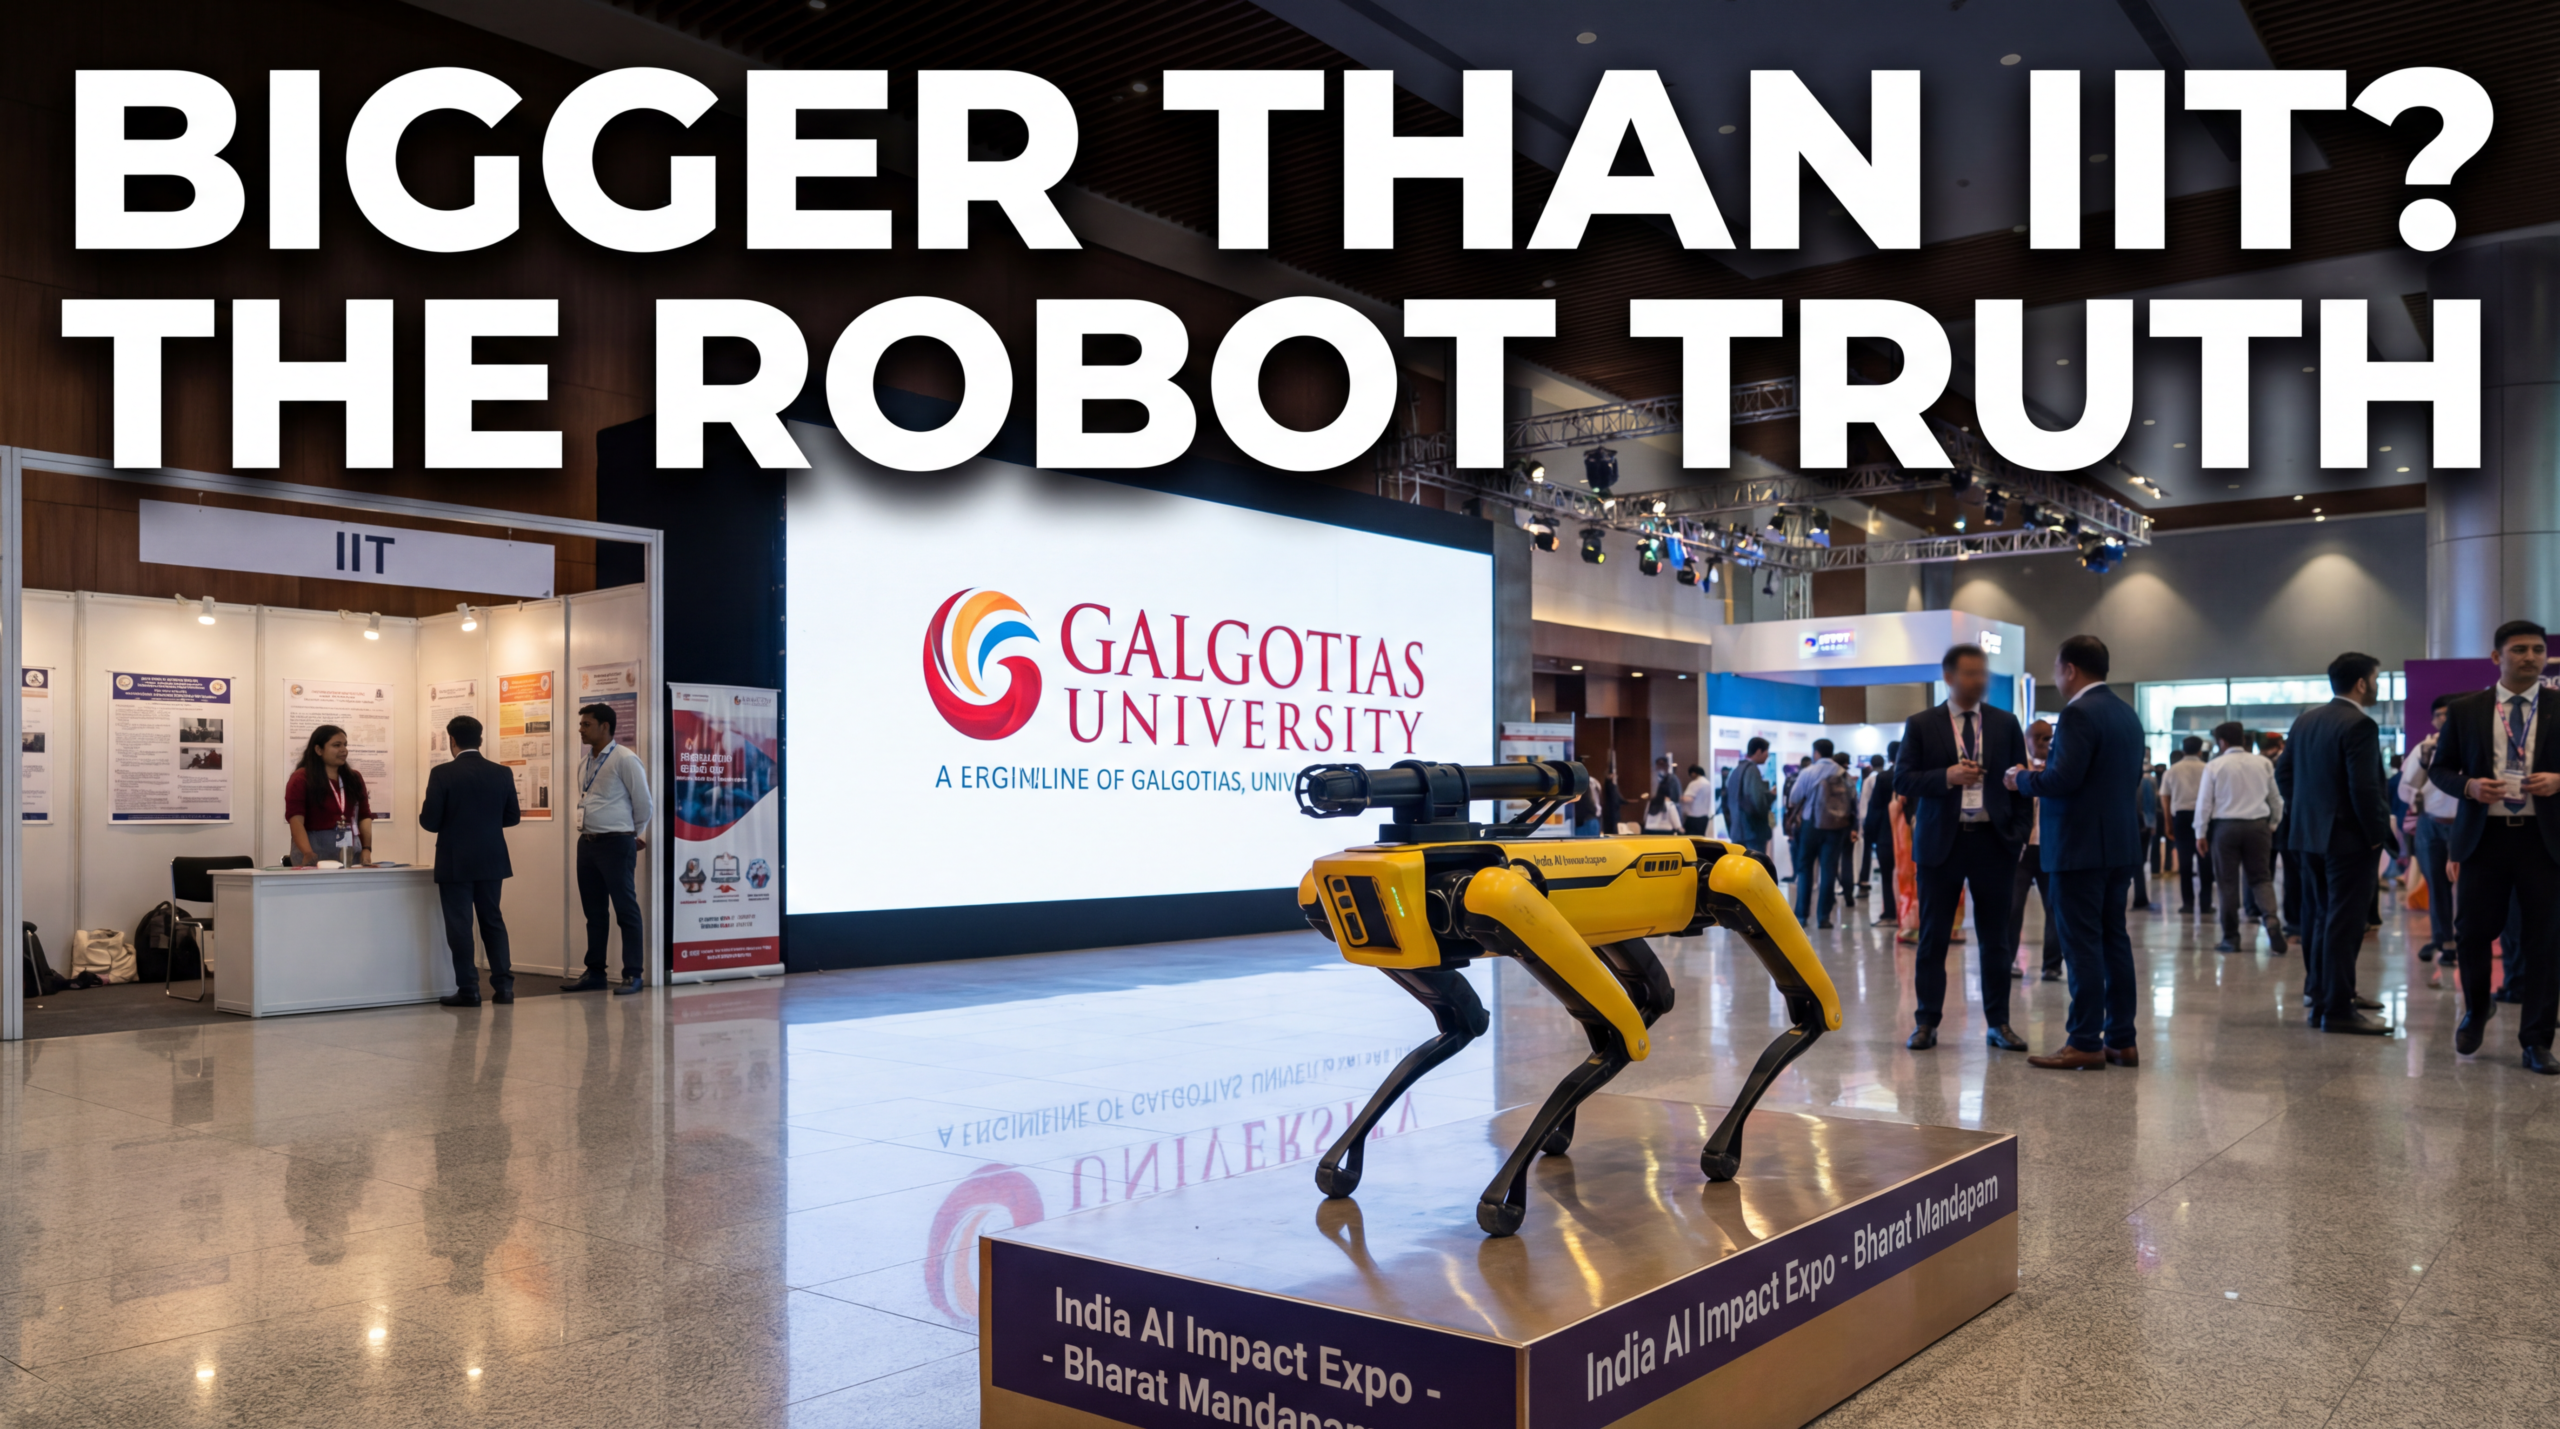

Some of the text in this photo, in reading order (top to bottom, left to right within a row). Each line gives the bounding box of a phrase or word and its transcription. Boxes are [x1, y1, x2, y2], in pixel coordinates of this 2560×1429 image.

[336, 531, 396, 575] IIT
[1060, 602, 1425, 699] GALGOTIAS
[1064, 688, 1423, 754] UNIVERSITY
[935, 765, 952, 789] A
[1097, 768, 1125, 791] OF
[1131, 769, 1246, 795] GALGOTIAS,
[1251, 771, 1297, 792] UNIV
[1587, 1330, 1656, 1402] India
[1663, 1308, 1690, 1365] AI
[1699, 1271, 1780, 1347] Impact
[1785, 1253, 1835, 1303] Expo
[1854, 1209, 1912, 1270] Bharat
[1916, 1174, 1998, 1239] Mandapam
[1055, 1286, 1131, 1339] India
[1140, 1306, 1174, 1349] AI
[1187, 1315, 1308, 1381] Impact
[1319, 1345, 1413, 1407] Expo
[1064, 1343, 1169, 1406] Bharat
[1179, 1372, 1376, 1429] Manda
